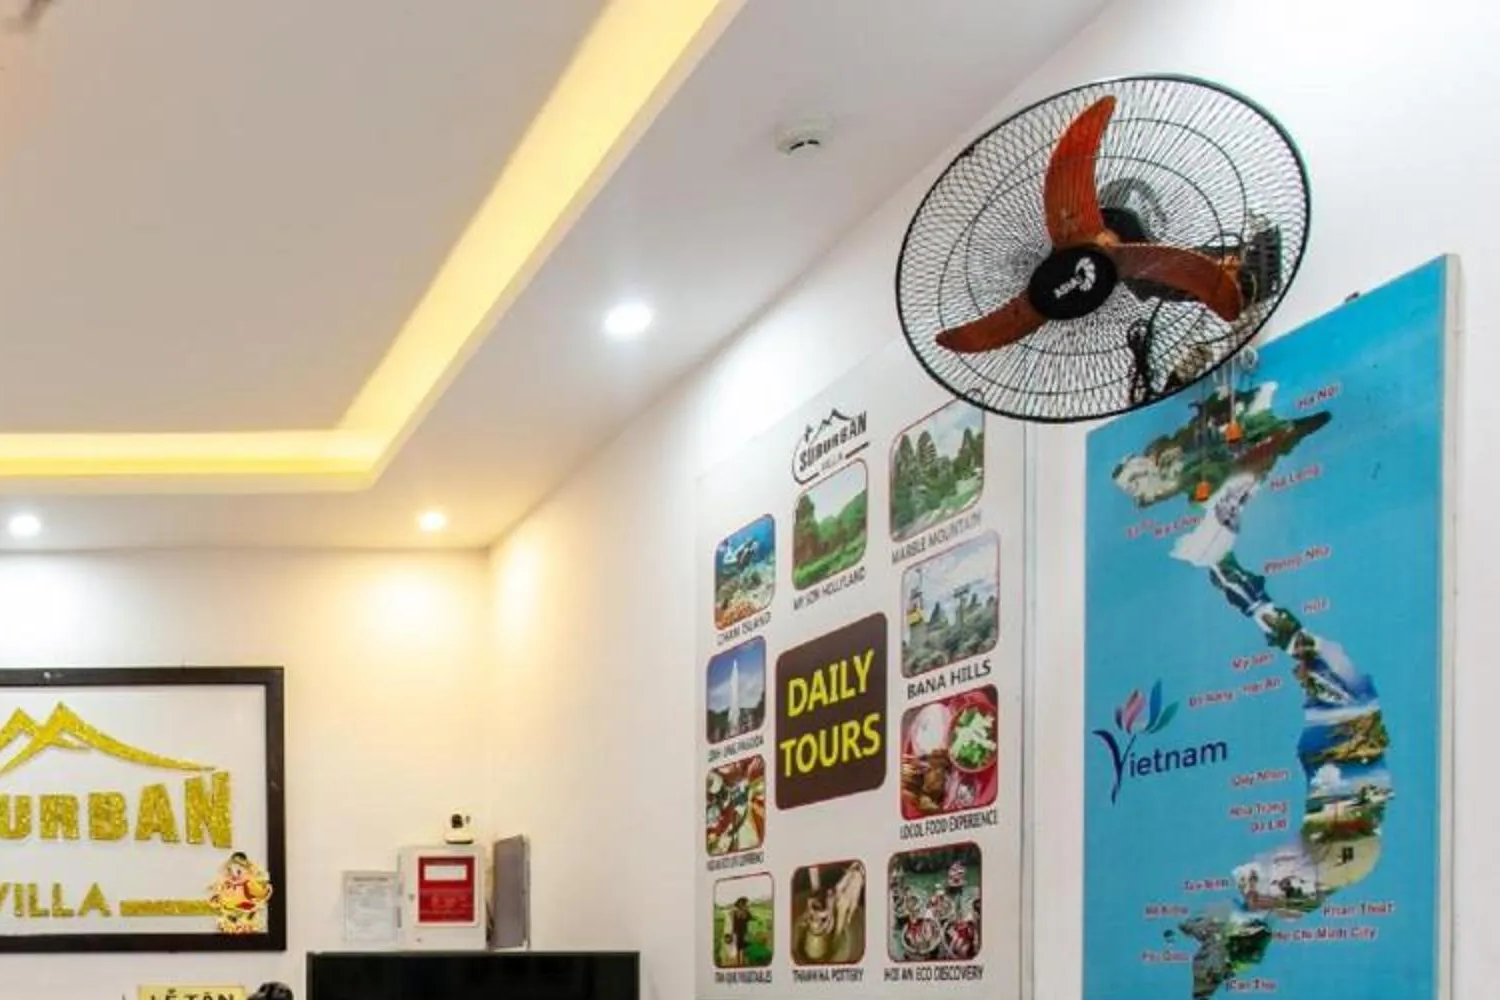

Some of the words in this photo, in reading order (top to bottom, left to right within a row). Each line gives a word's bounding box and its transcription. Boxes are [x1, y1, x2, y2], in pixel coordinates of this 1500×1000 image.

[799, 410, 867, 472] SUBURBAN
[786, 648, 875, 719] DAILY
[907, 672, 947, 700] BANA
[950, 657, 992, 688] HILLS
[779, 711, 881, 778] TOURS
[1092, 729, 1228, 807] Vietnam
[925, 818, 949, 835] FOOD
[915, 966, 933, 981] ECO
[934, 965, 984, 981] DISCOVERY
